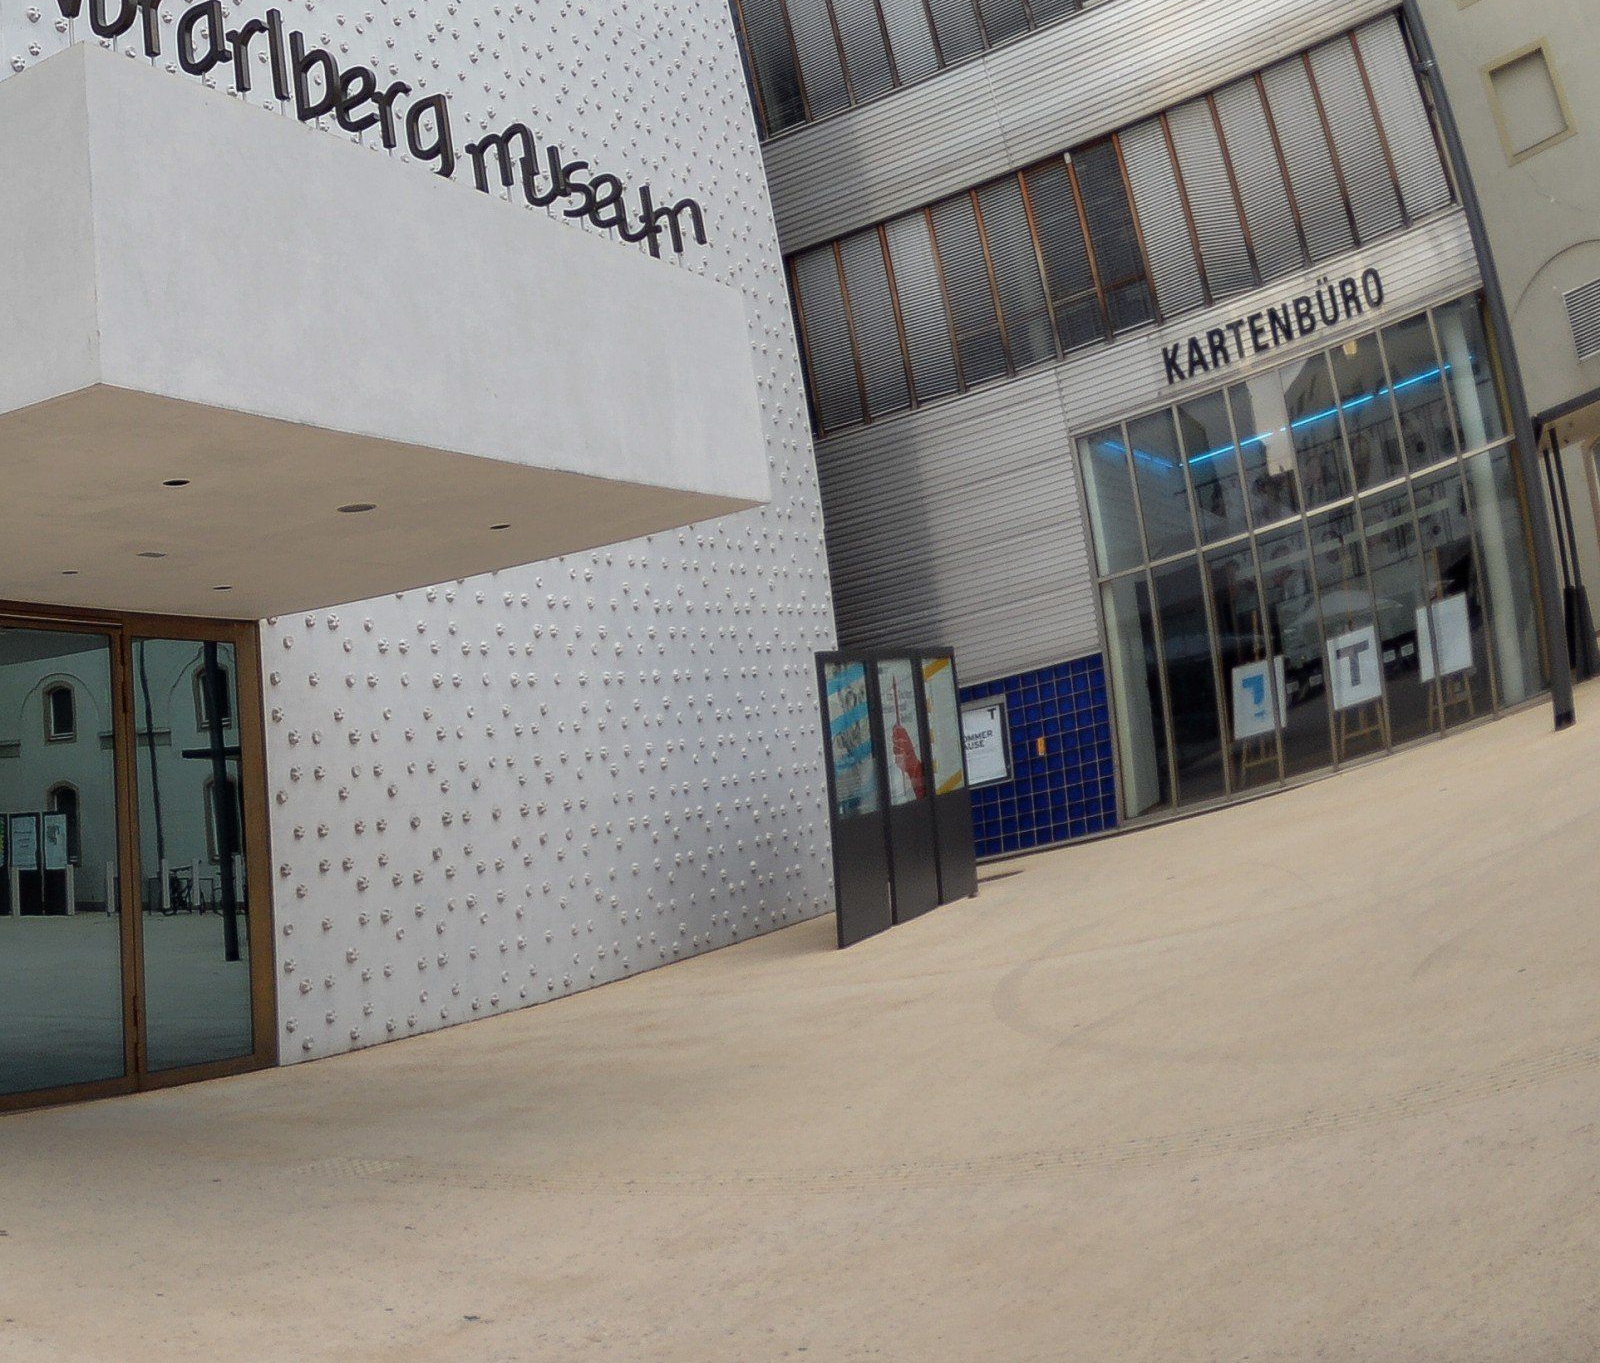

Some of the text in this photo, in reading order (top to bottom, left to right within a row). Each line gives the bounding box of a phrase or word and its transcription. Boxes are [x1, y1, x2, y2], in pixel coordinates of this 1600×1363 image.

[465, 123, 707, 257] museum
[1162, 268, 1384, 385] KARTENBÜRO
[987, 707, 997, 720] T
